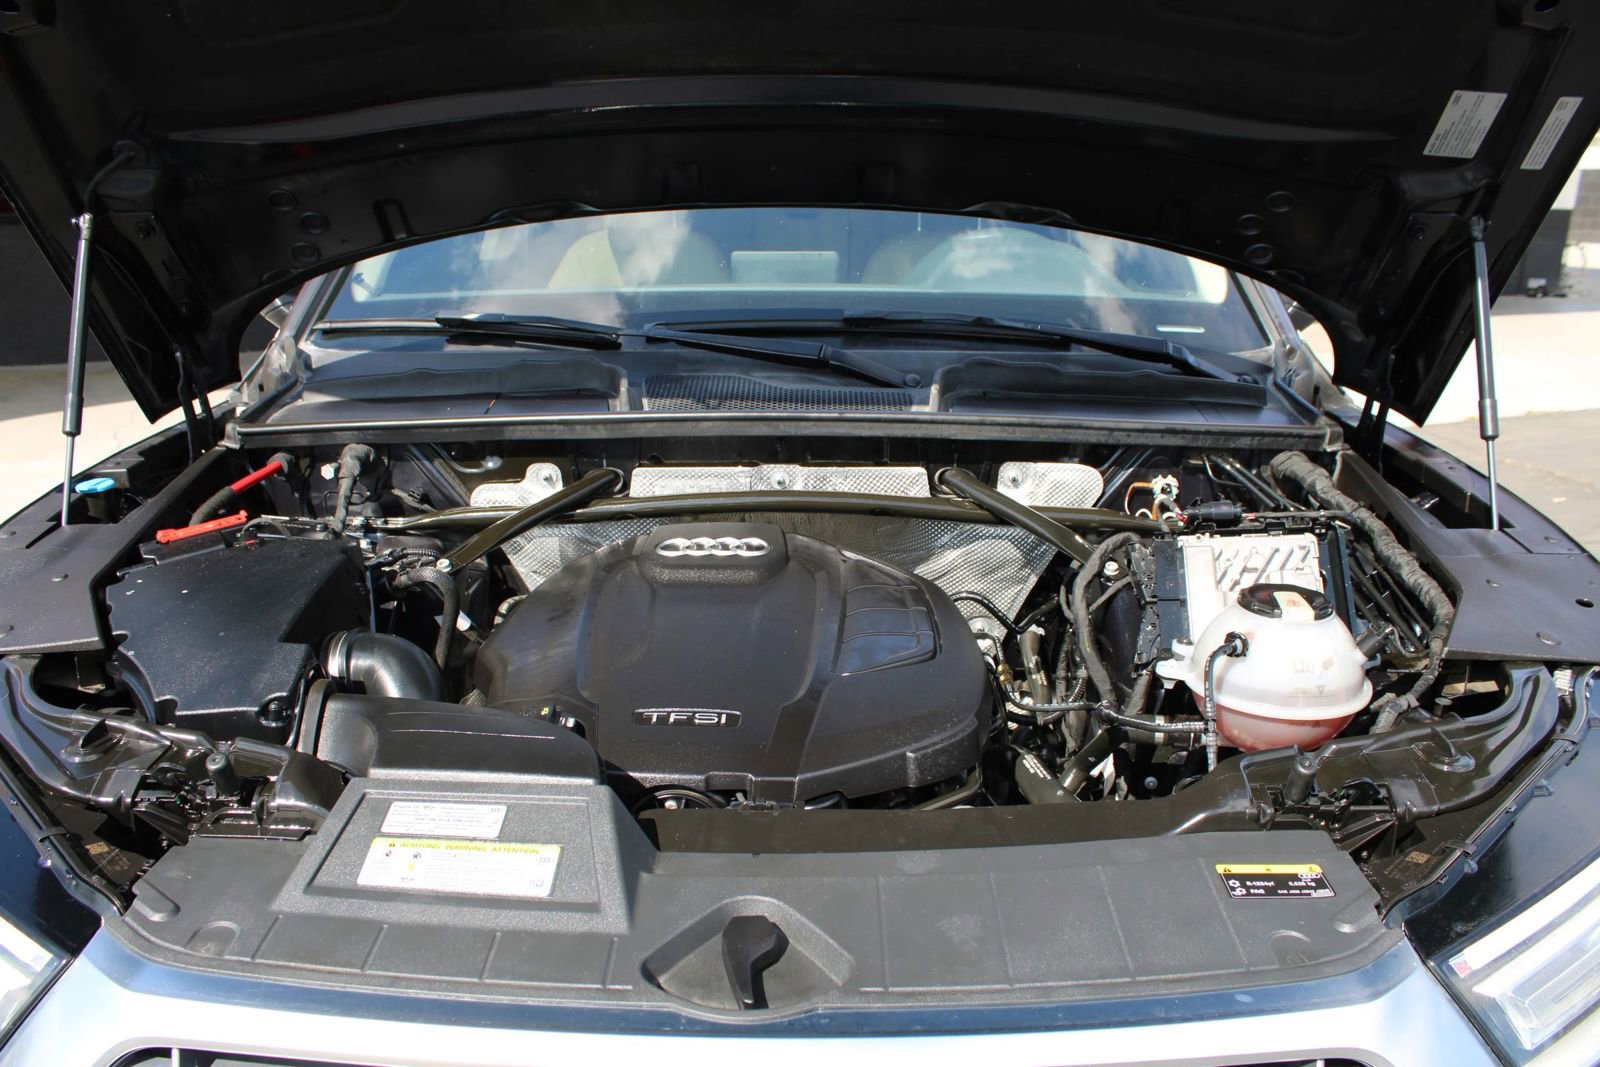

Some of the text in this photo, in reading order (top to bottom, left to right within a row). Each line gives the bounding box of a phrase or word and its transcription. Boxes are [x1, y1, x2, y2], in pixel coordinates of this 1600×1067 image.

[643, 712, 727, 726] TFSI
[446, 843, 487, 852] WARNING
[491, 846, 540, 854] ATTENTION
